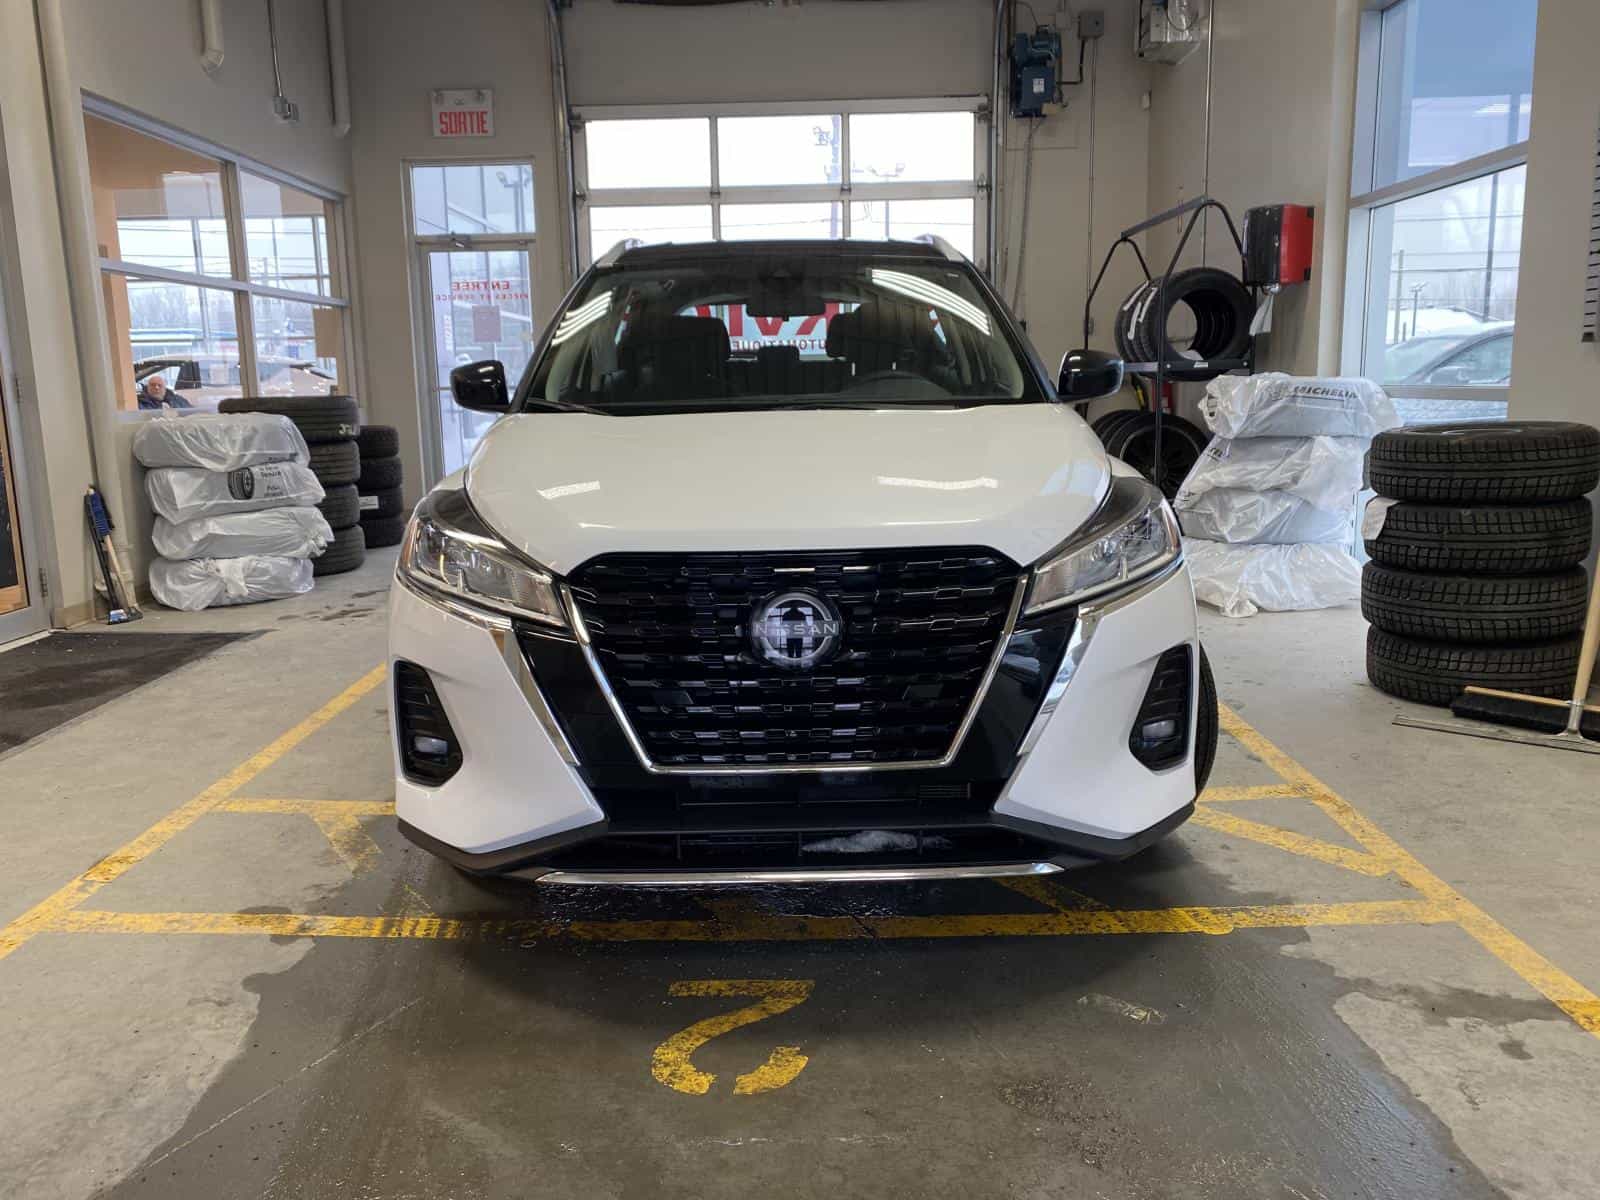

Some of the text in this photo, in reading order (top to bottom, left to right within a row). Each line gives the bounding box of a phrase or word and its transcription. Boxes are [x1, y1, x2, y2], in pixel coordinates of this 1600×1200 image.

[439, 111, 488, 135] SORTIE
[1294, 385, 1358, 398] MICHELIN
[755, 623, 836, 634] NSSAN
[651, 979, 816, 1096] 2
